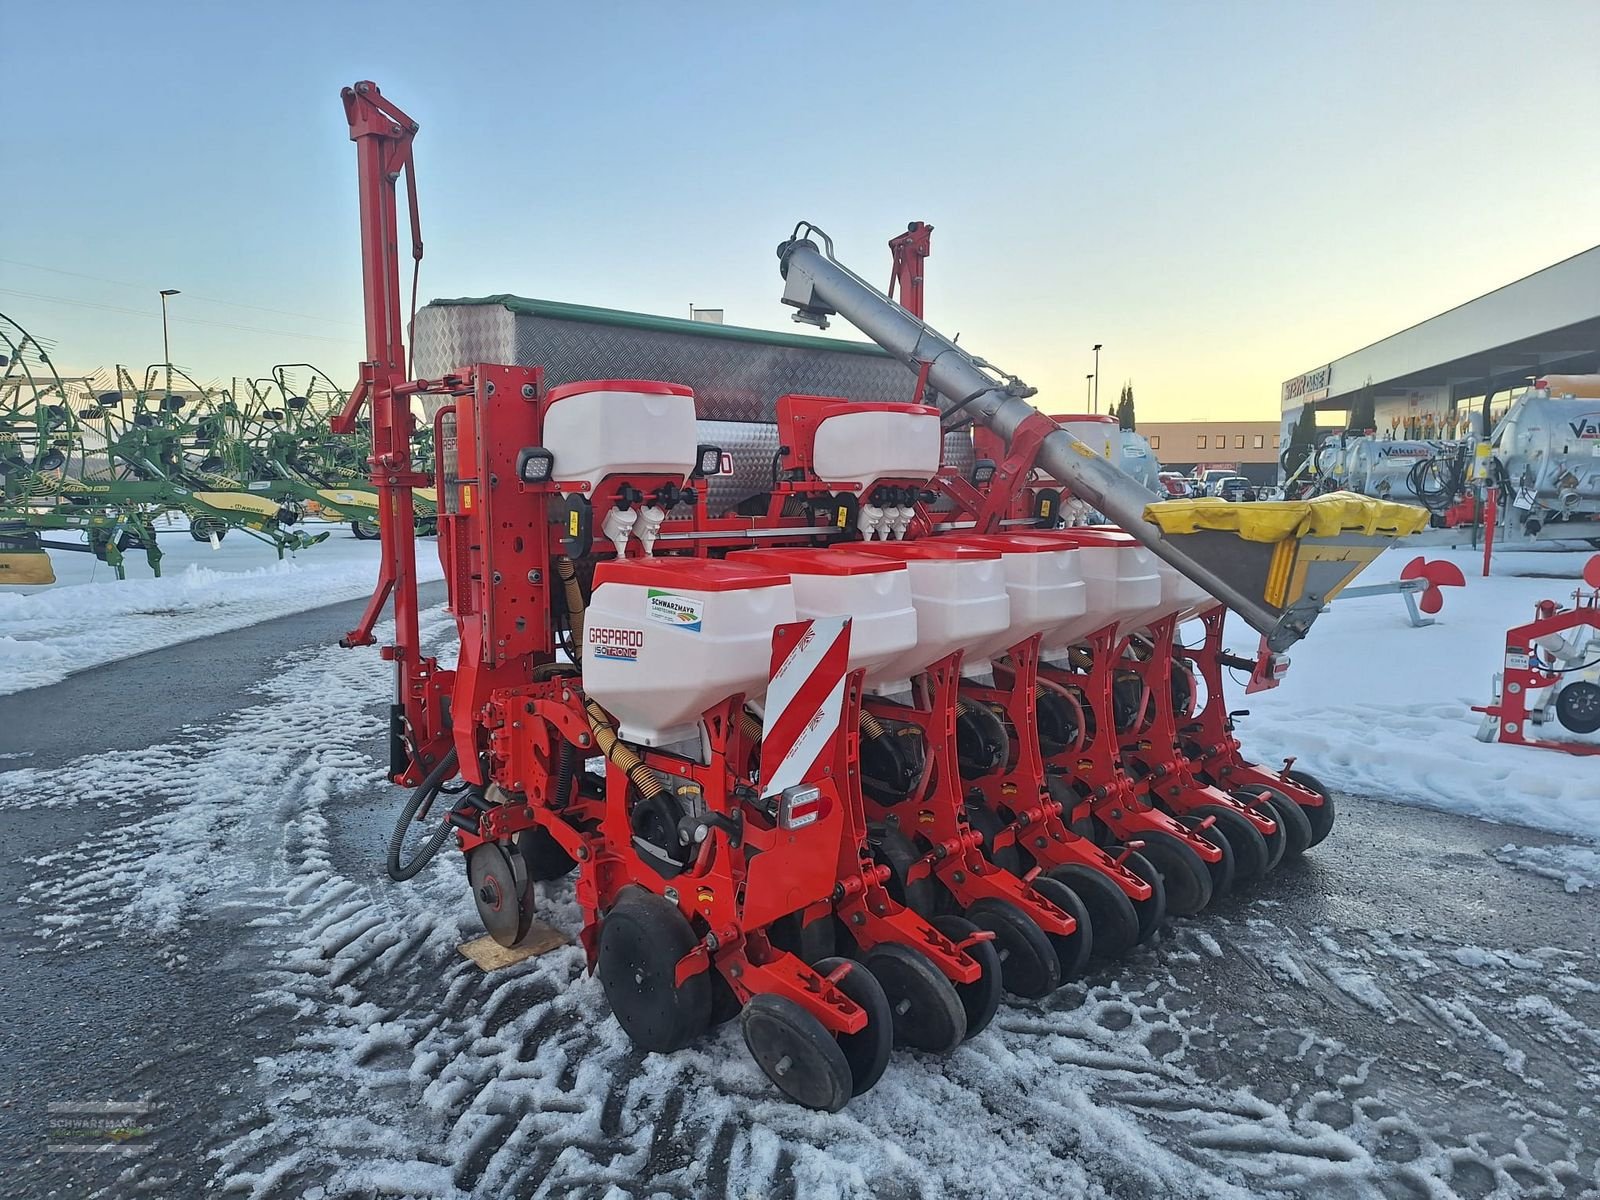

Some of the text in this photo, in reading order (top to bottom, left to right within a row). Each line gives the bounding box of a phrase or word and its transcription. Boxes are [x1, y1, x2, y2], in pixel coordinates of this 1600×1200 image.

[652, 598, 695, 614] SCHWARZMAYR
[589, 627, 643, 648] GASPARDO
[595, 645, 637, 658] ISOTRONIC
